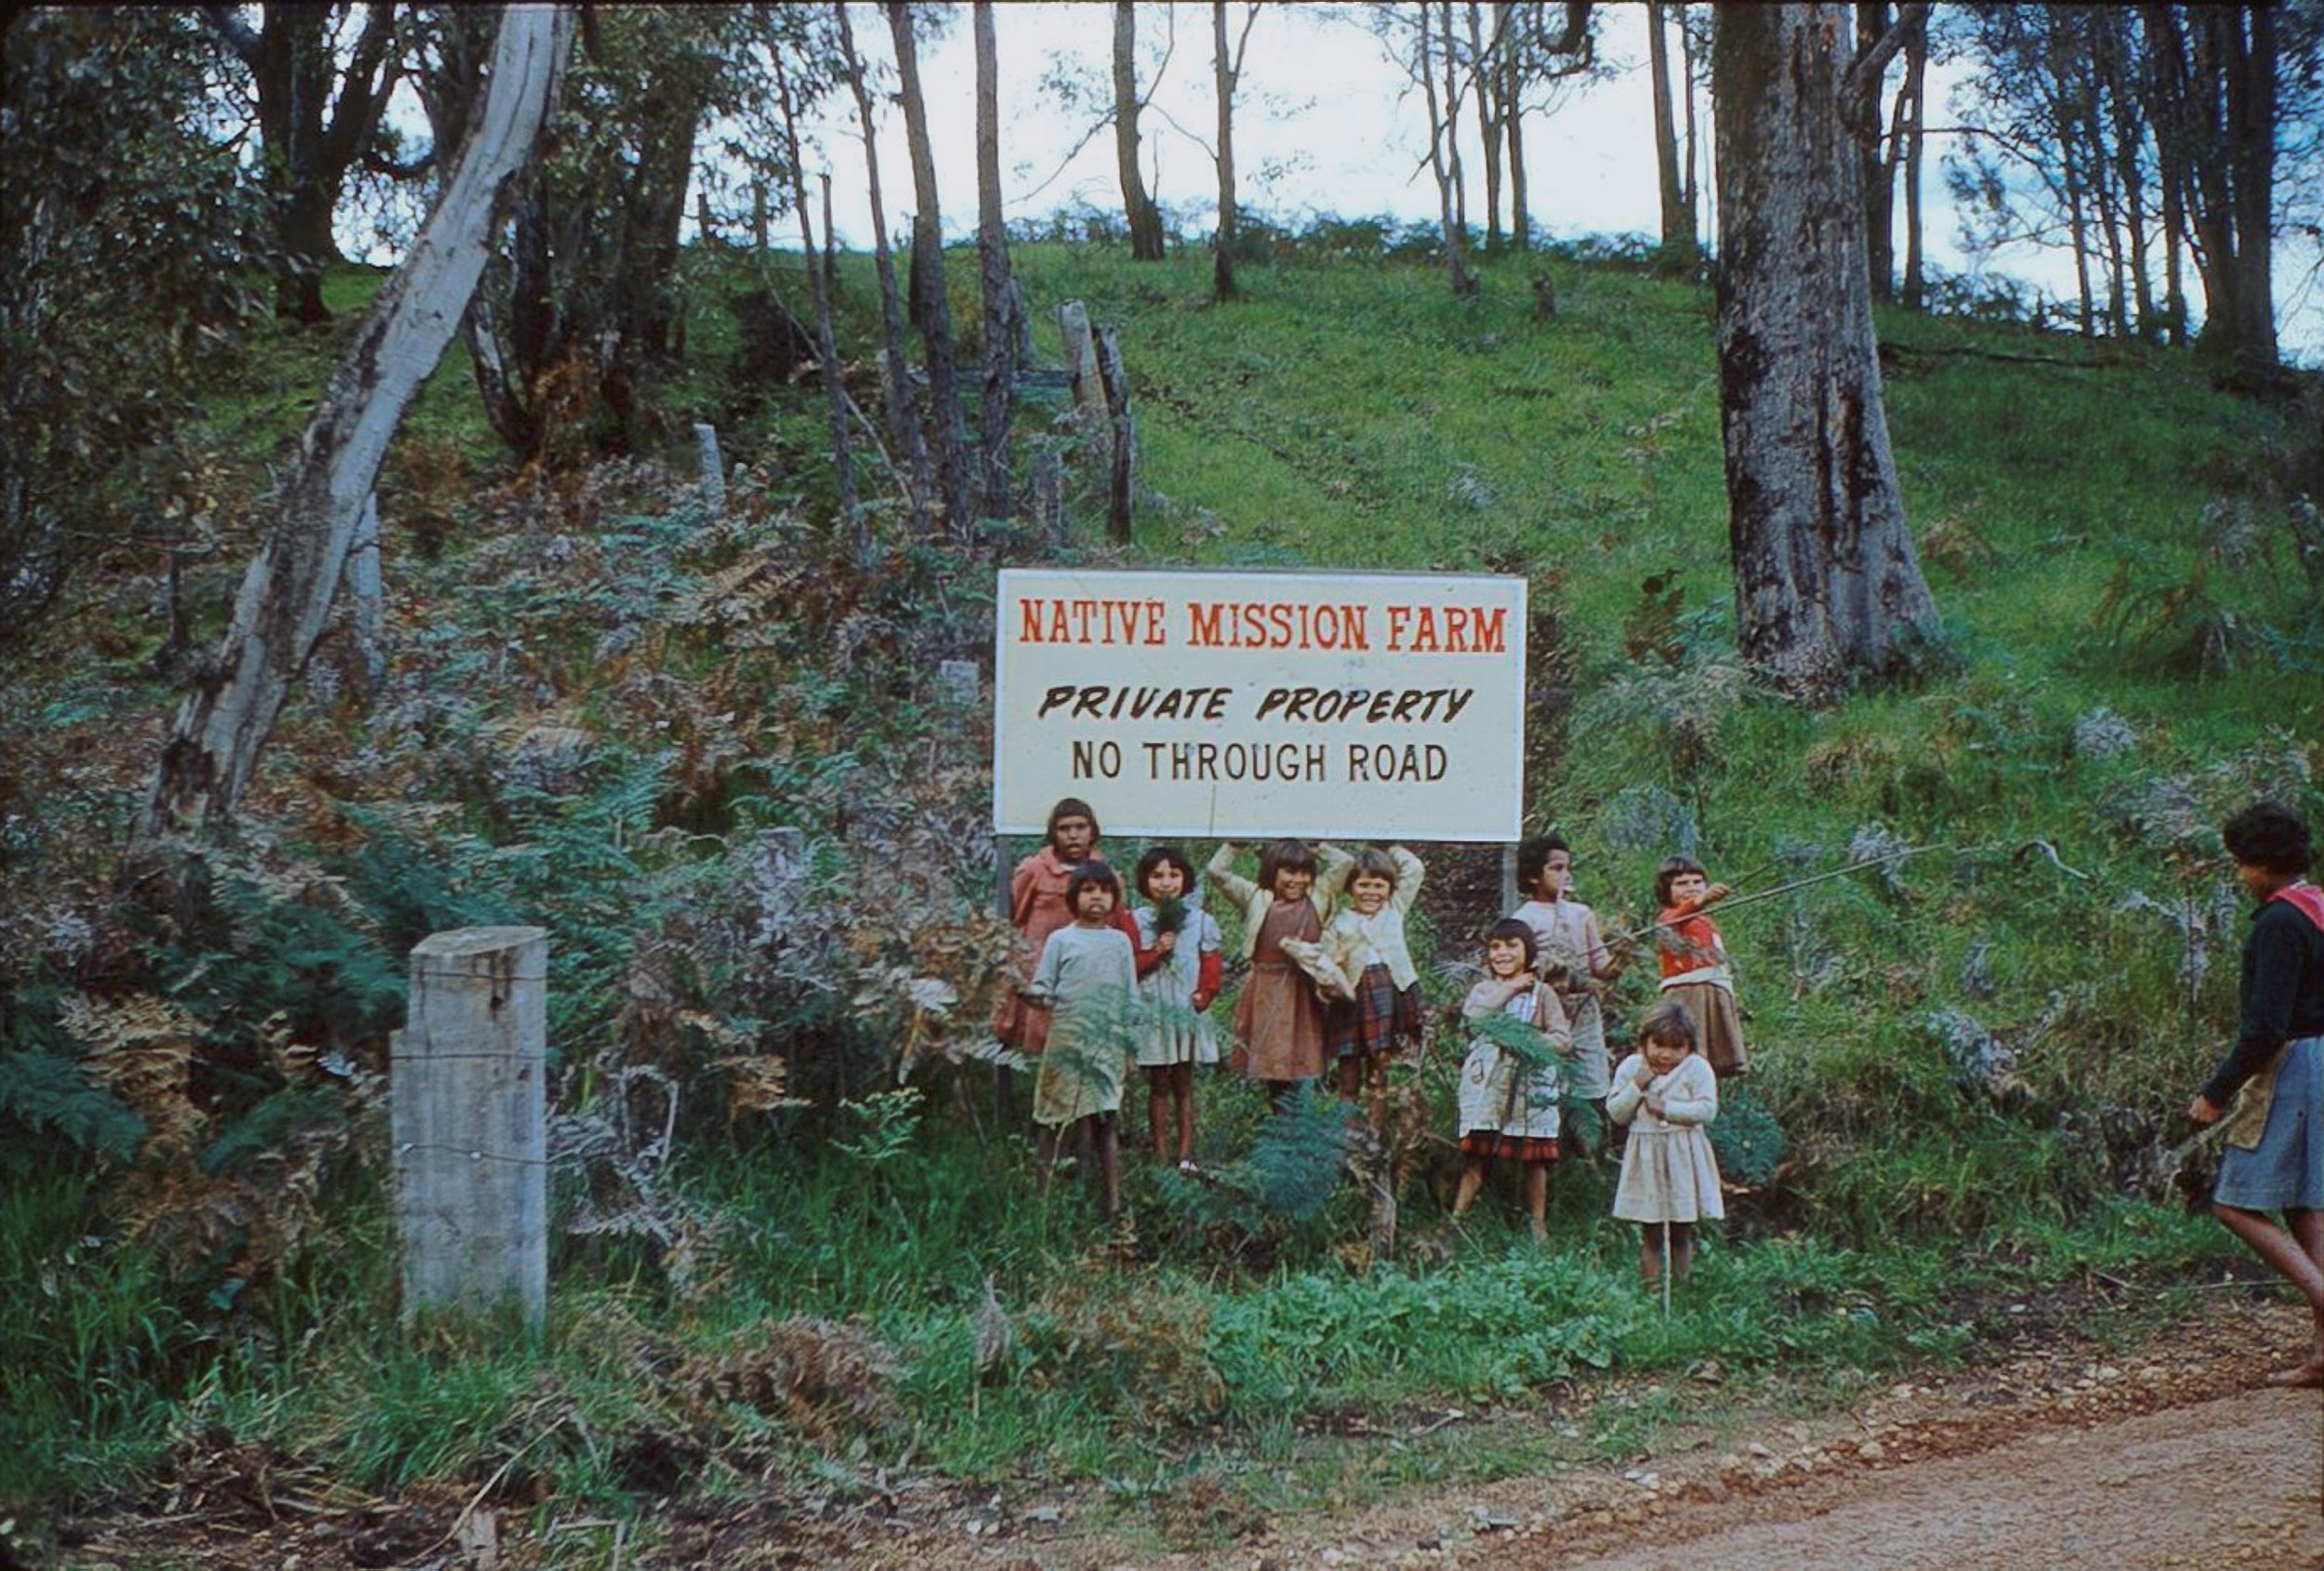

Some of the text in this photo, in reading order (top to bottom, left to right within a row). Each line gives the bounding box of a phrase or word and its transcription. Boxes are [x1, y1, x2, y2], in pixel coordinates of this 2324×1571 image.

[1020, 599, 1507, 653] NATIVE MISSION FARM
[1037, 686, 1472, 723] PRIVATE PROPERTY
[1073, 741, 1447, 783] NO THROUGH ROAD
